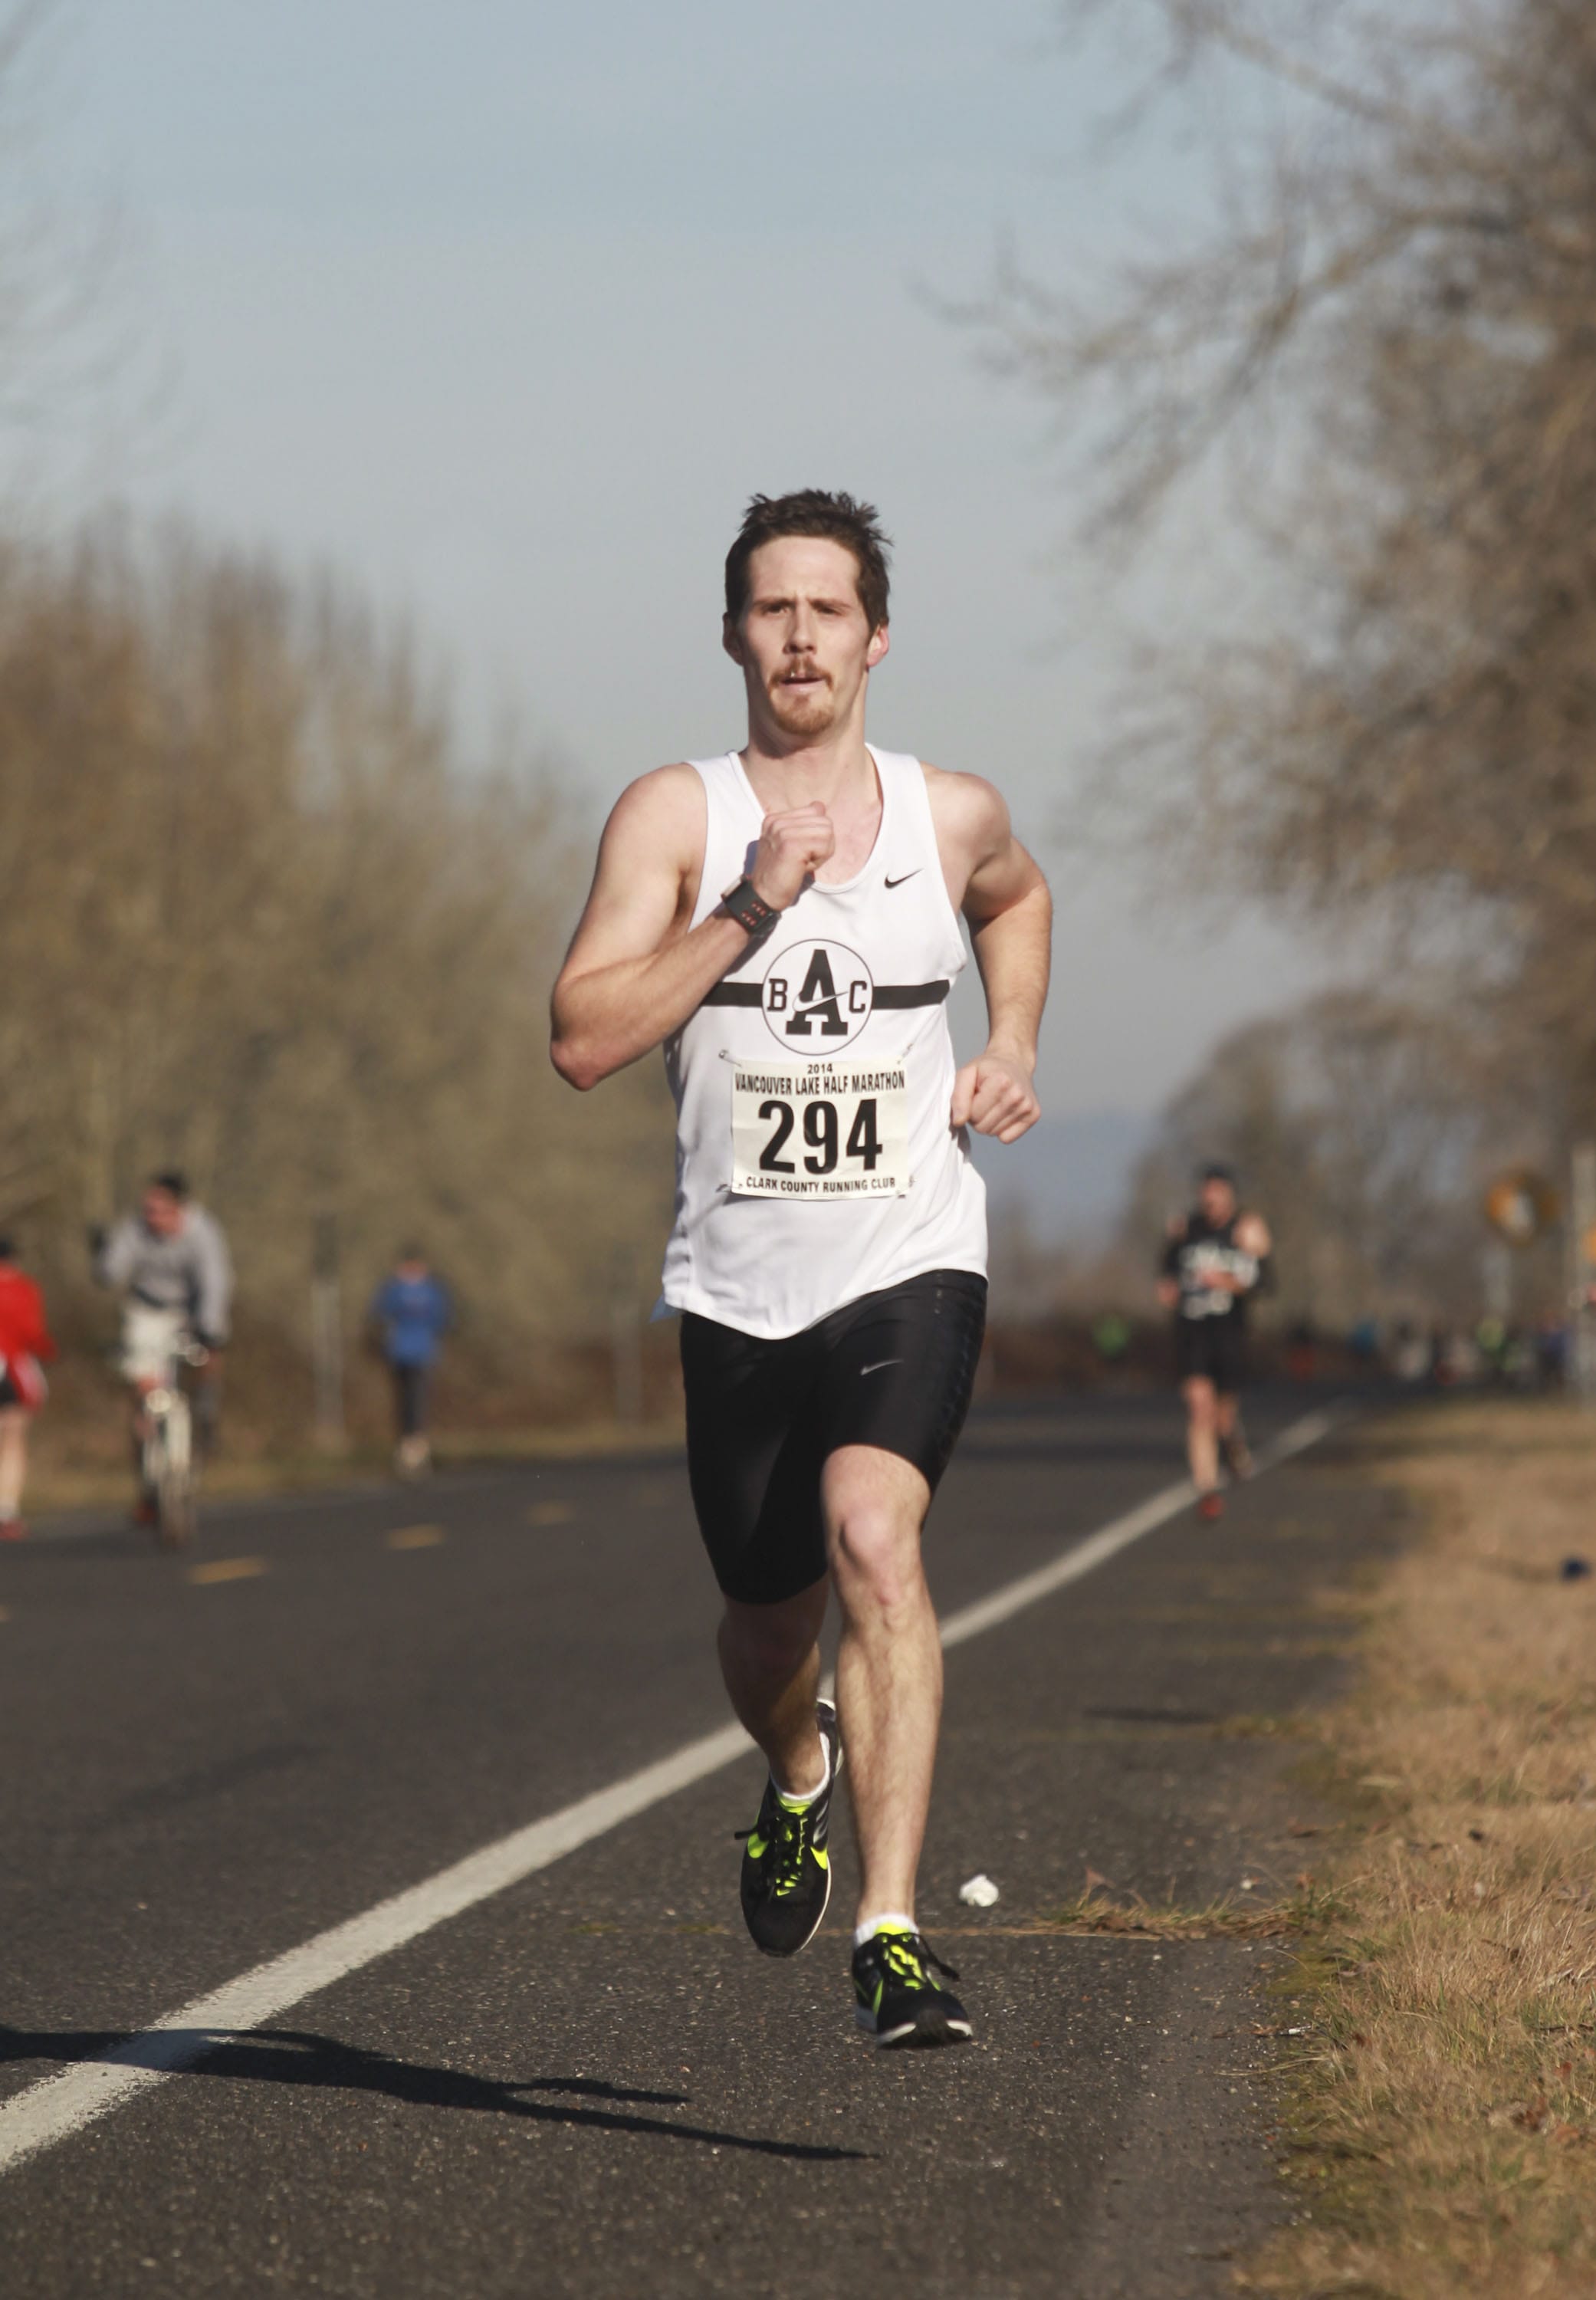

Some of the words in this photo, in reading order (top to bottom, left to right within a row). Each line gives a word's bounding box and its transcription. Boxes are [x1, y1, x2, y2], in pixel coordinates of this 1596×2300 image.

[807, 1063, 832, 1074] 2014
[735, 1073, 792, 1096] VANCOUVER
[796, 1076, 819, 1096] LAKE
[823, 1075, 848, 1095] HALF
[852, 1070, 905, 1093] MARATHON
[758, 1099, 882, 1175] 294
[747, 1176, 778, 1191] CLARK
[780, 1181, 819, 1193] COUNTY
[823, 1179, 869, 1193] RUNNING
[871, 1176, 896, 1189] CLUB
